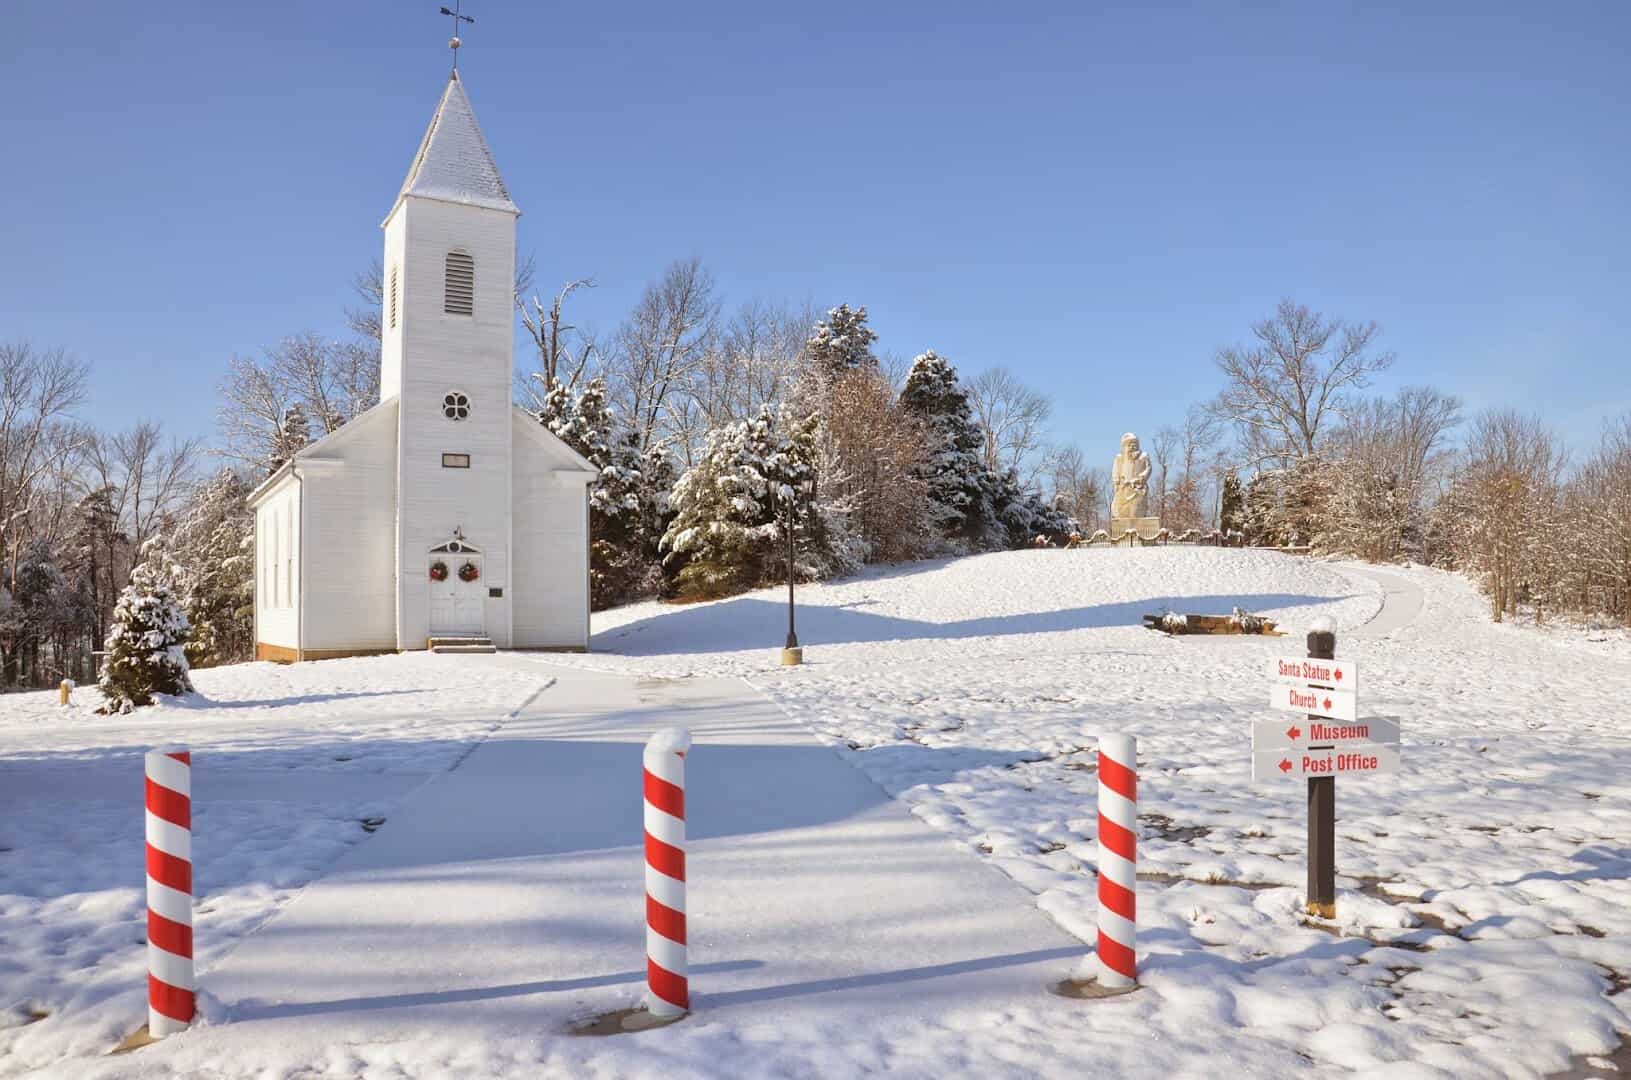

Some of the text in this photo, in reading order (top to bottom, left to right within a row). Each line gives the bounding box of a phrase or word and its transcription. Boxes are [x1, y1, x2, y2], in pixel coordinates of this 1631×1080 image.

[1278, 659, 1330, 681] Santa Statue
[1289, 689, 1317, 709] Church
[1310, 724, 1369, 740] Museum
[1302, 753, 1378, 773] Post Office
